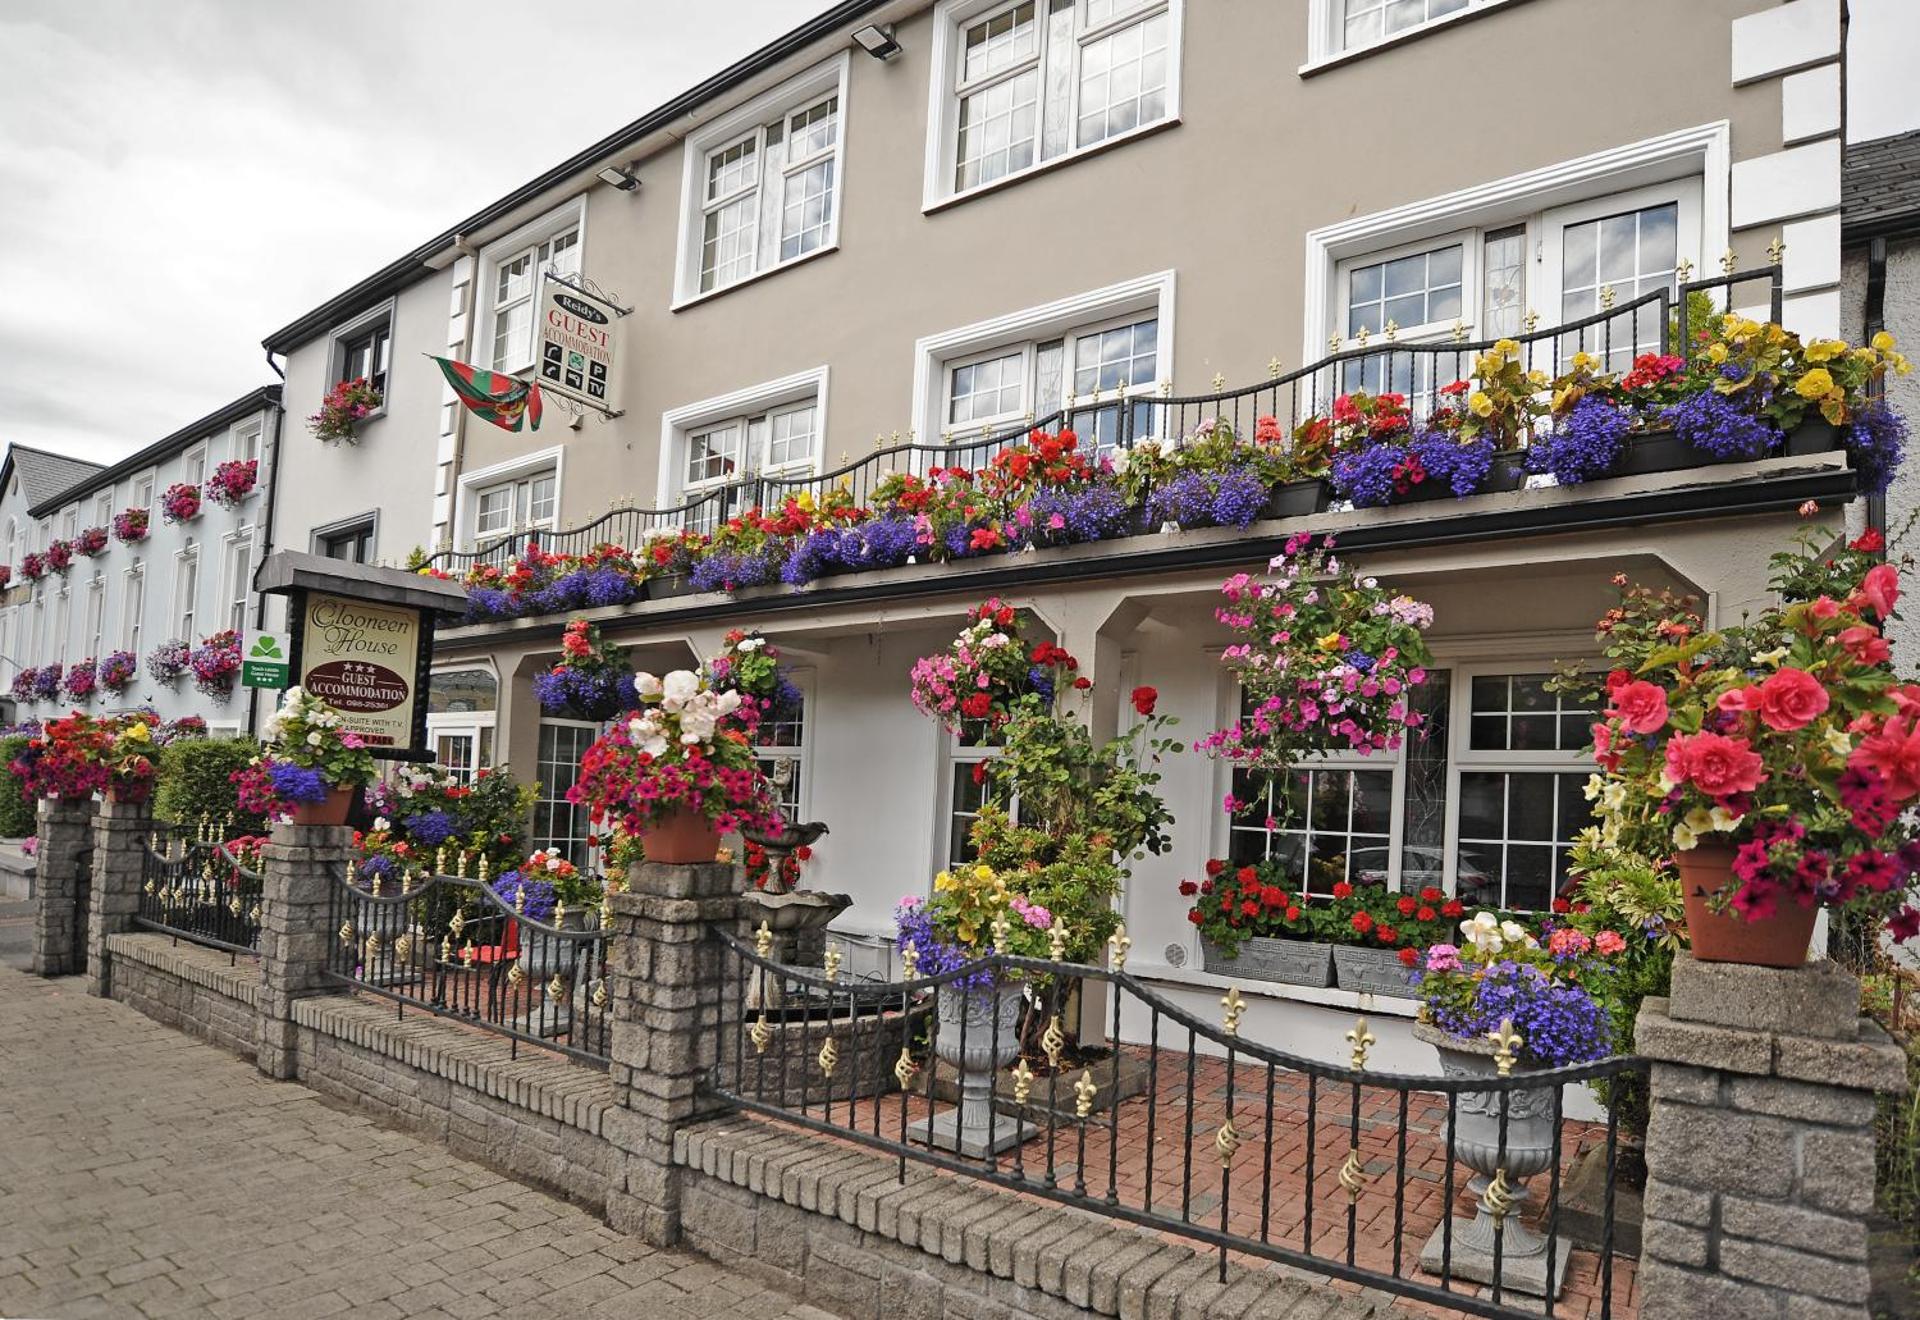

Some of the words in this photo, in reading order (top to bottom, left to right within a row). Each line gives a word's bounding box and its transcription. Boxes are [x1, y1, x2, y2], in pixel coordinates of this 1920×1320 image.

[562, 296, 602, 321] Reidy's
[549, 309, 609, 347] GUEST
[544, 327, 611, 365] ACCOMMODATION
[591, 382, 604, 395] TV
[312, 599, 409, 634] Clooneen
[323, 626, 398, 656] House
[310, 681, 405, 700] ACCOMMODATION
[342, 672, 377, 686] GUEST
